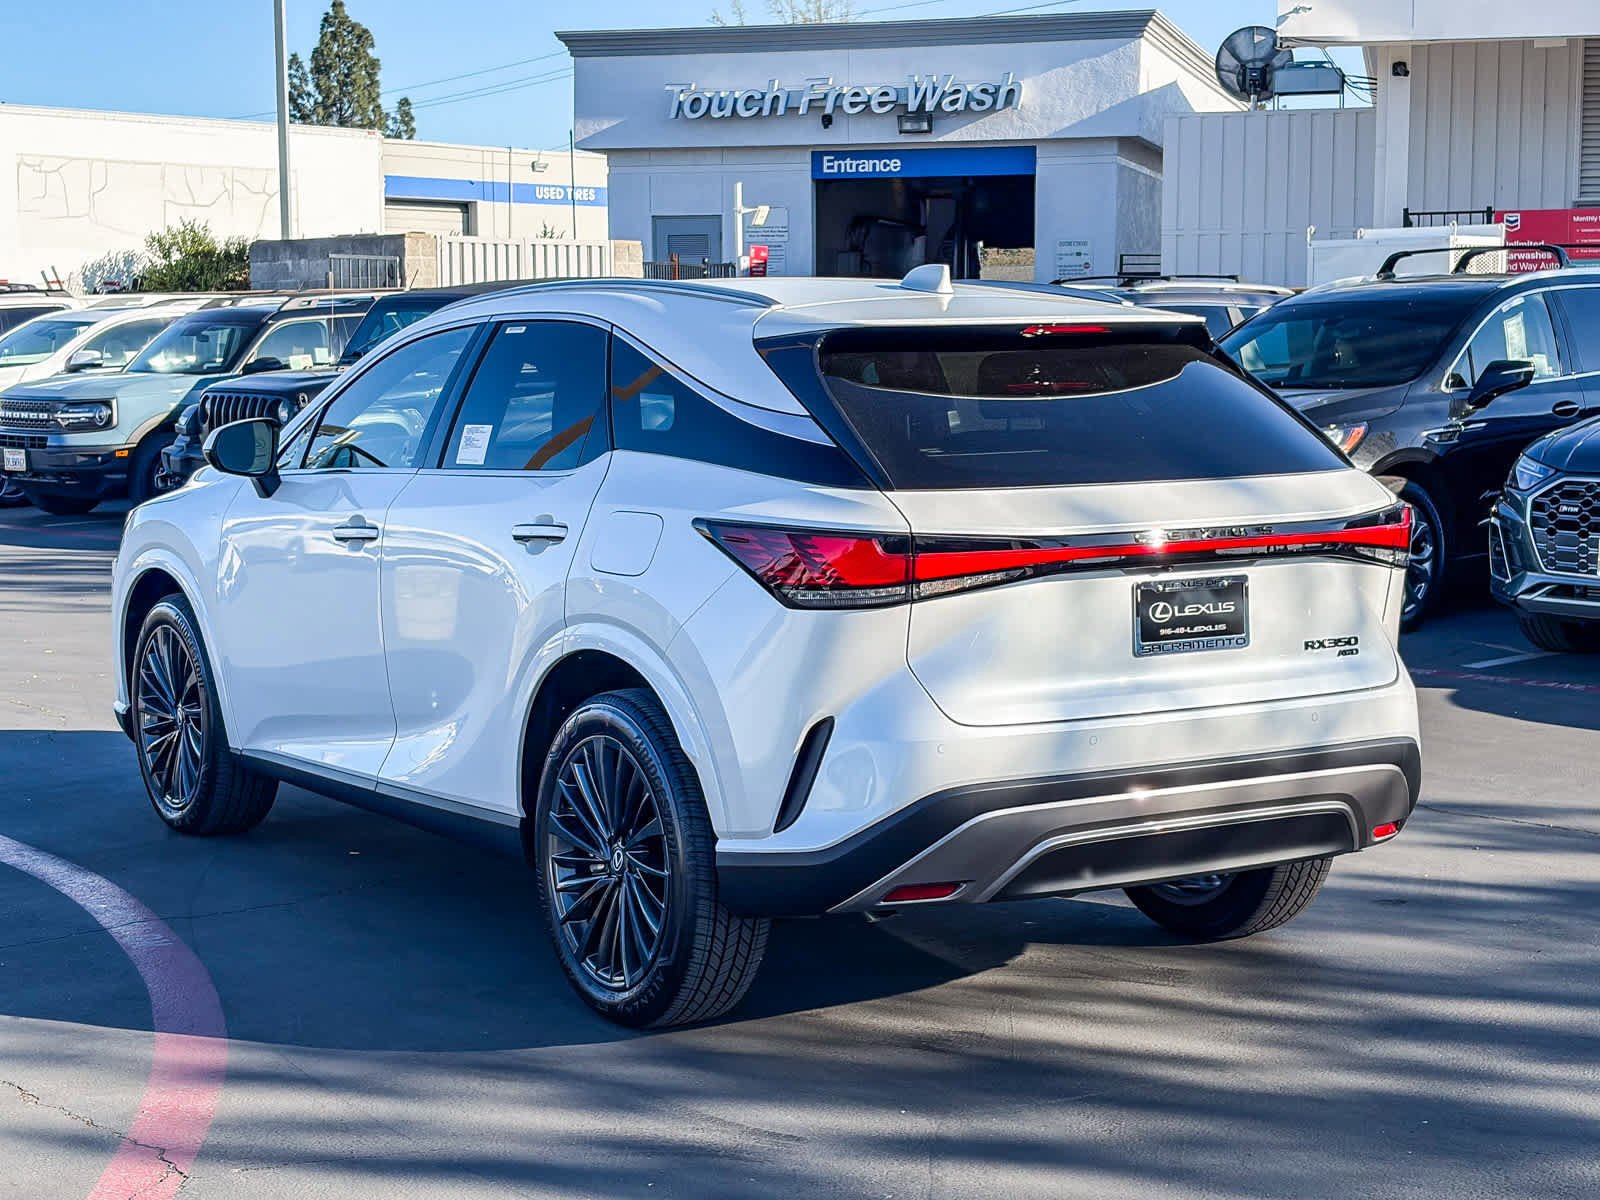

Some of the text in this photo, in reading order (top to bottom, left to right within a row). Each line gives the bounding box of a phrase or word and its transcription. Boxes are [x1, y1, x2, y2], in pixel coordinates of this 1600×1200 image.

[664, 72, 1024, 120] Touch Free Wash
[823, 155, 901, 173] Entrance
[535, 186, 596, 201] USED TRES
[1519, 262, 1538, 272] Way
[1540, 262, 1560, 270] Auto
[1174, 602, 1235, 616] LEXUS
[1141, 637, 1246, 654] SACRAMENTO
